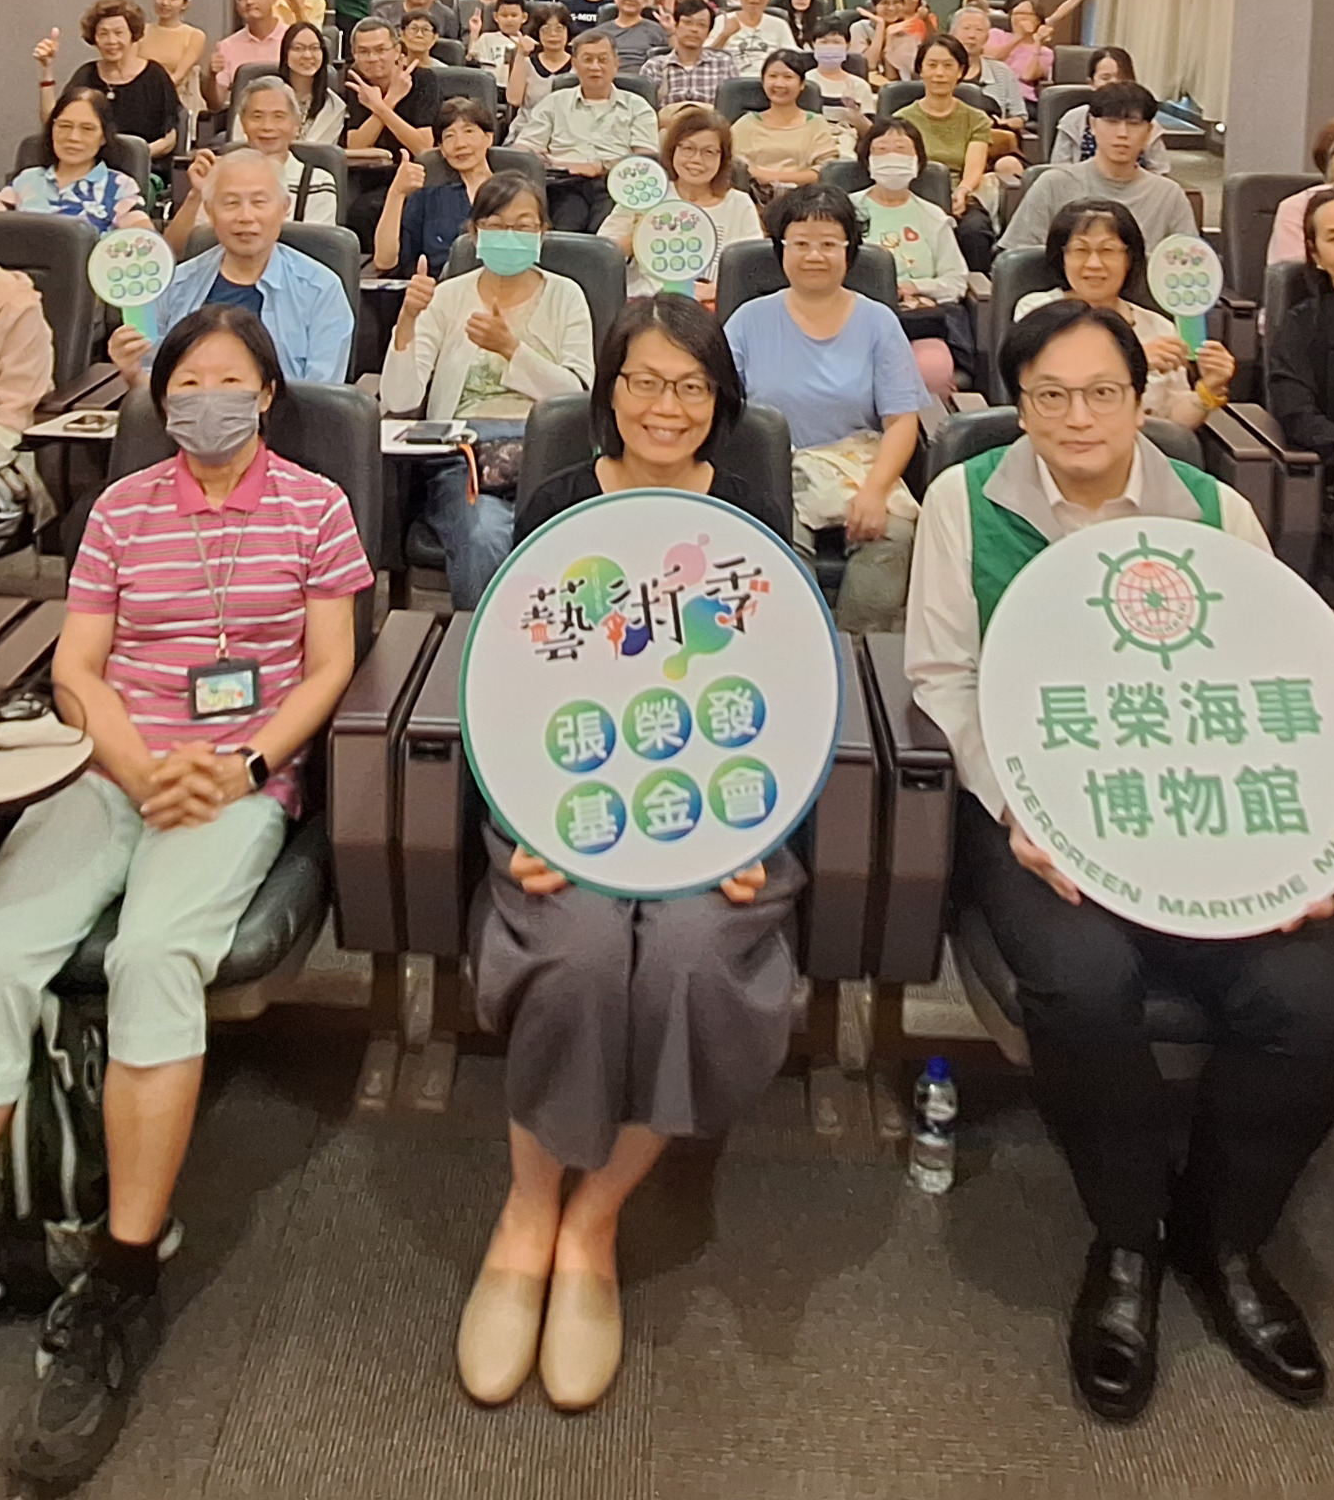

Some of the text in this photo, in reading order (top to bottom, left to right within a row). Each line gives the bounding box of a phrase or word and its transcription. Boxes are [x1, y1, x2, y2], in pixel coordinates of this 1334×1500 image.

[520, 555, 772, 661] 藝術季
[554, 685, 760, 764] 張榮發
[1035, 676, 1322, 751] 長榮海事
[566, 765, 768, 847] 基金會
[1005, 755, 1144, 905] EVERGREEN
[1157, 873, 1309, 920] MARITIME
[1083, 765, 1310, 839] 博物館
